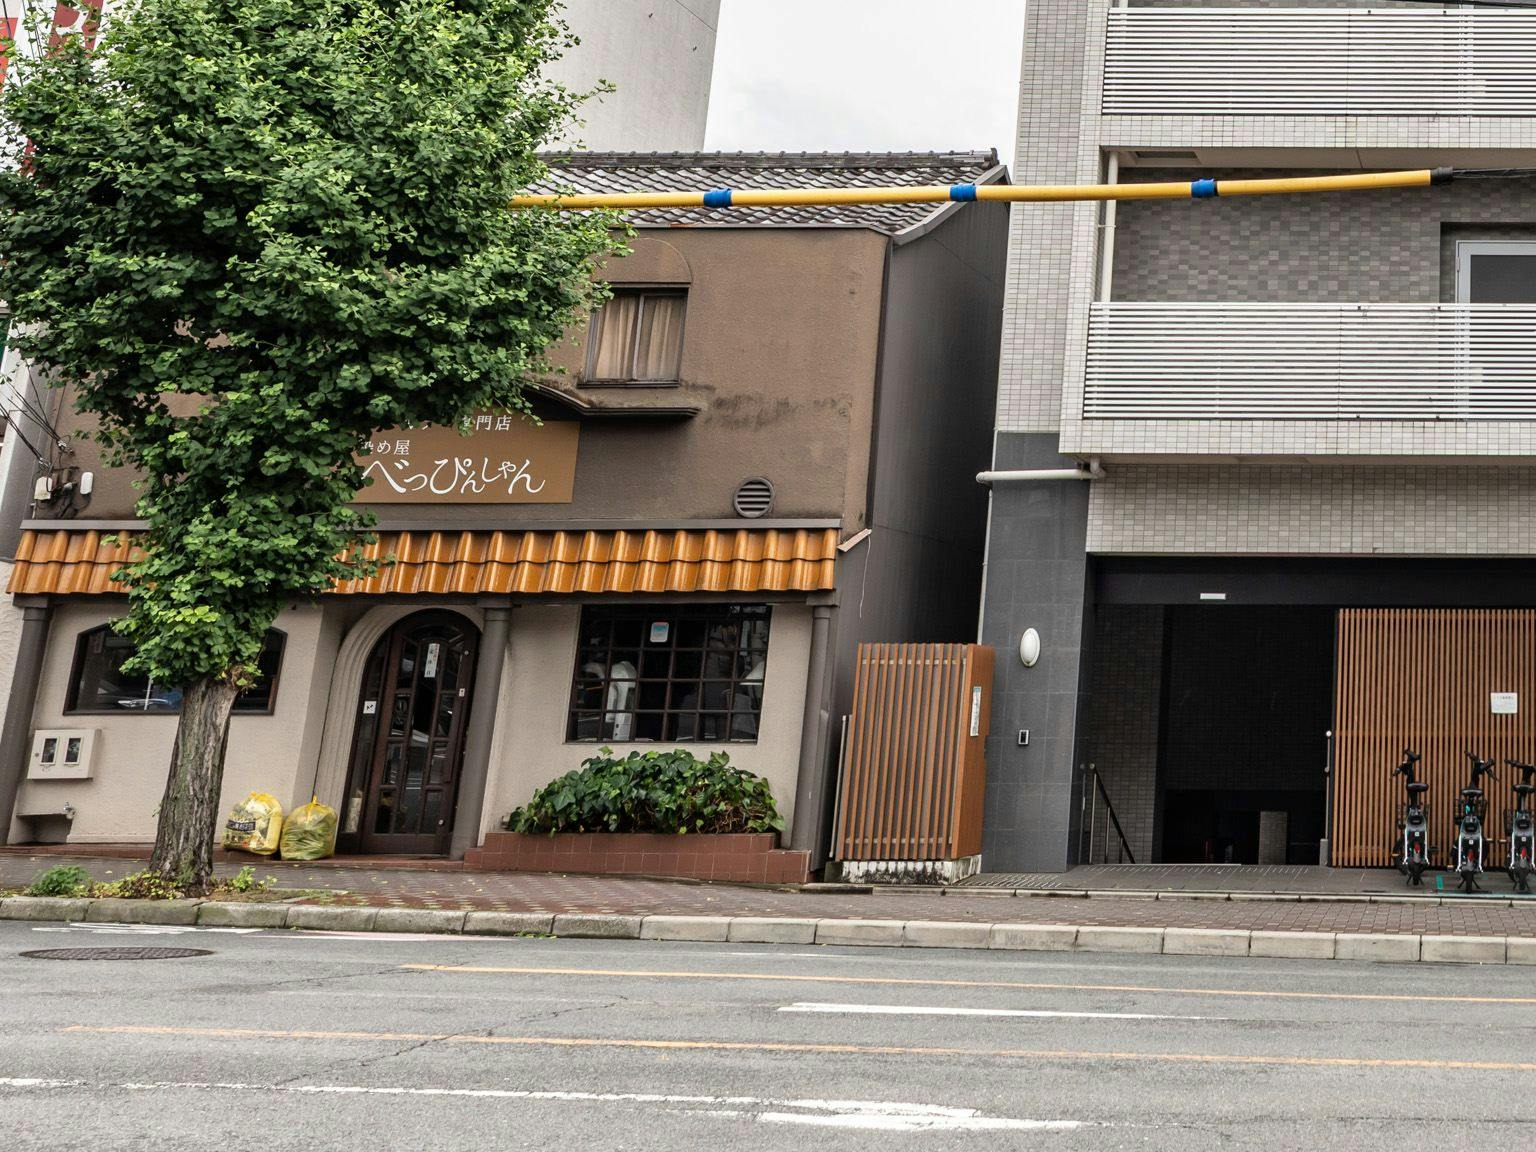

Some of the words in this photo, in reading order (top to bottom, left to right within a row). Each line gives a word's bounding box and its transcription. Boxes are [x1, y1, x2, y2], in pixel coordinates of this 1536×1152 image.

[361, 456, 546, 495] べっぴんしゃん
